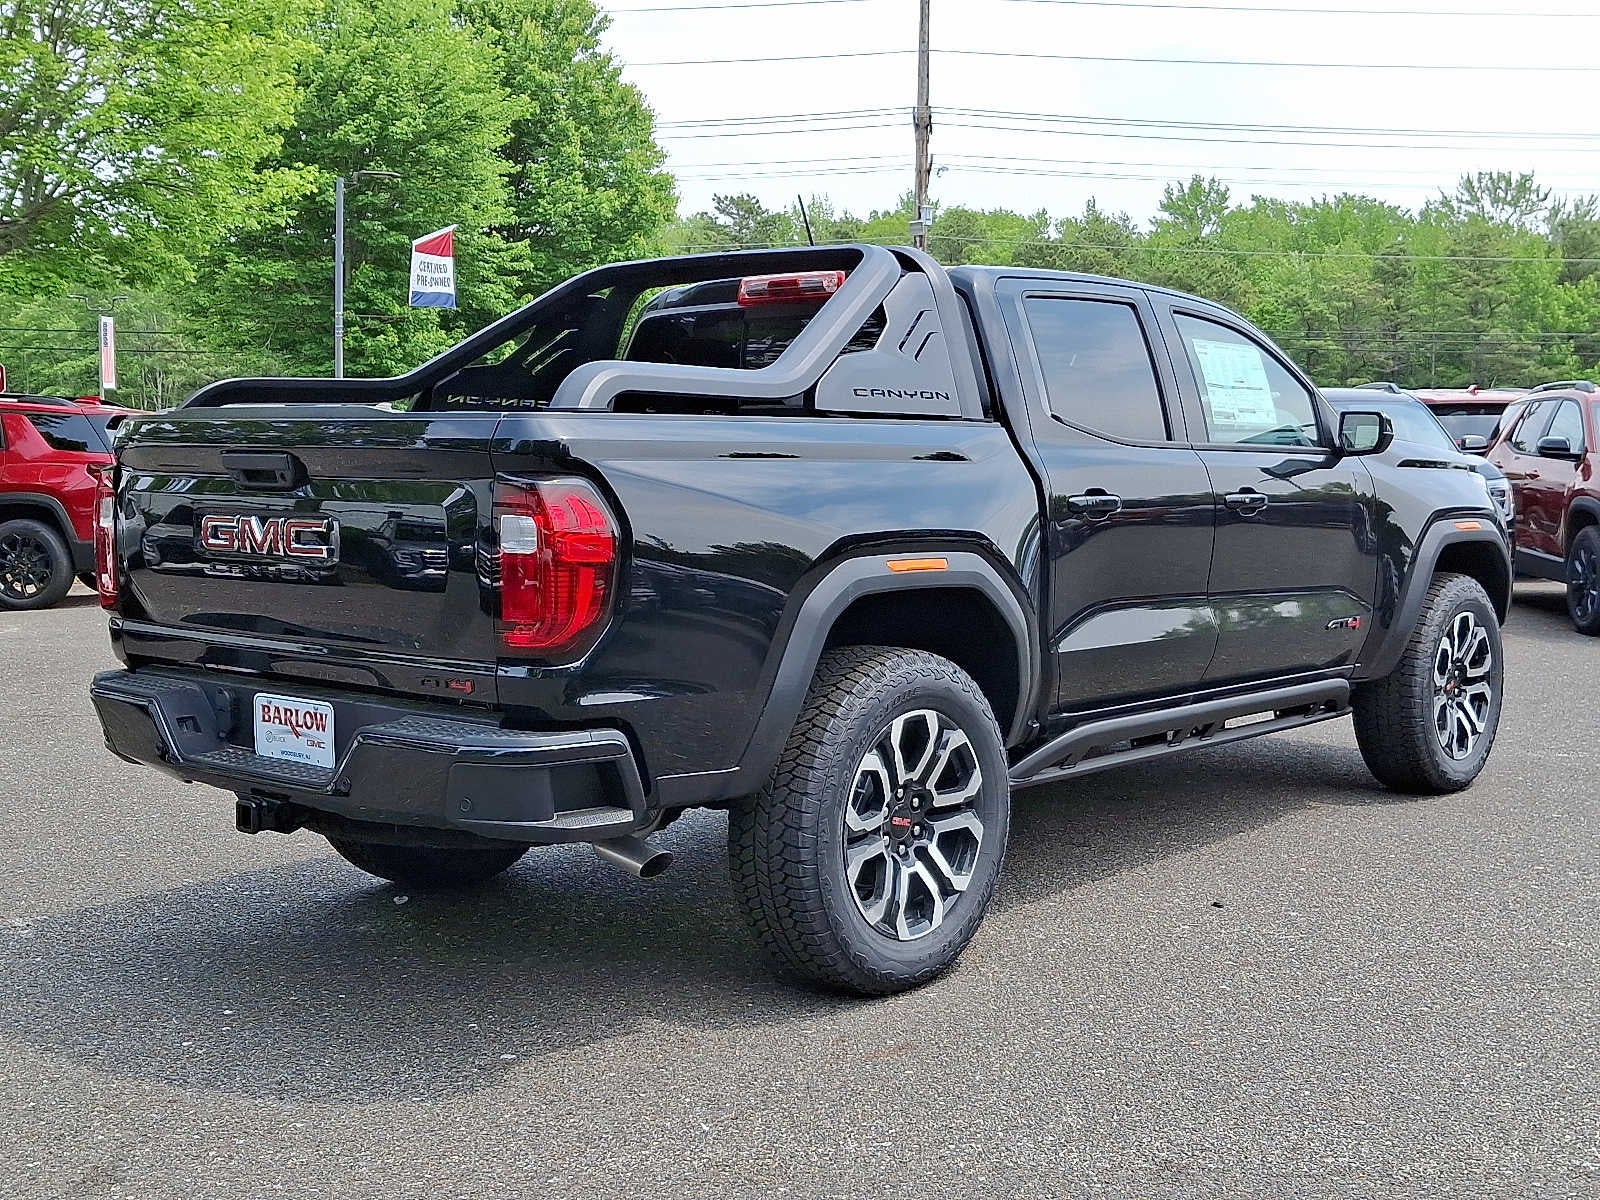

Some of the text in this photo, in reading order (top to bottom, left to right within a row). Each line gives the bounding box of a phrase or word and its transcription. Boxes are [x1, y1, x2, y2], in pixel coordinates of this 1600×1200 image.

[418, 260, 448, 274] CERTIFIED
[416, 274, 451, 287] PRE-OWNED
[852, 388, 950, 401] CANYON
[201, 514, 339, 560] GMC
[1325, 616, 1361, 630] AT4
[421, 677, 475, 695] AT4
[261, 704, 328, 739] BARLOW
[306, 738, 326, 750] GMC
[891, 816, 911, 827] GMC
